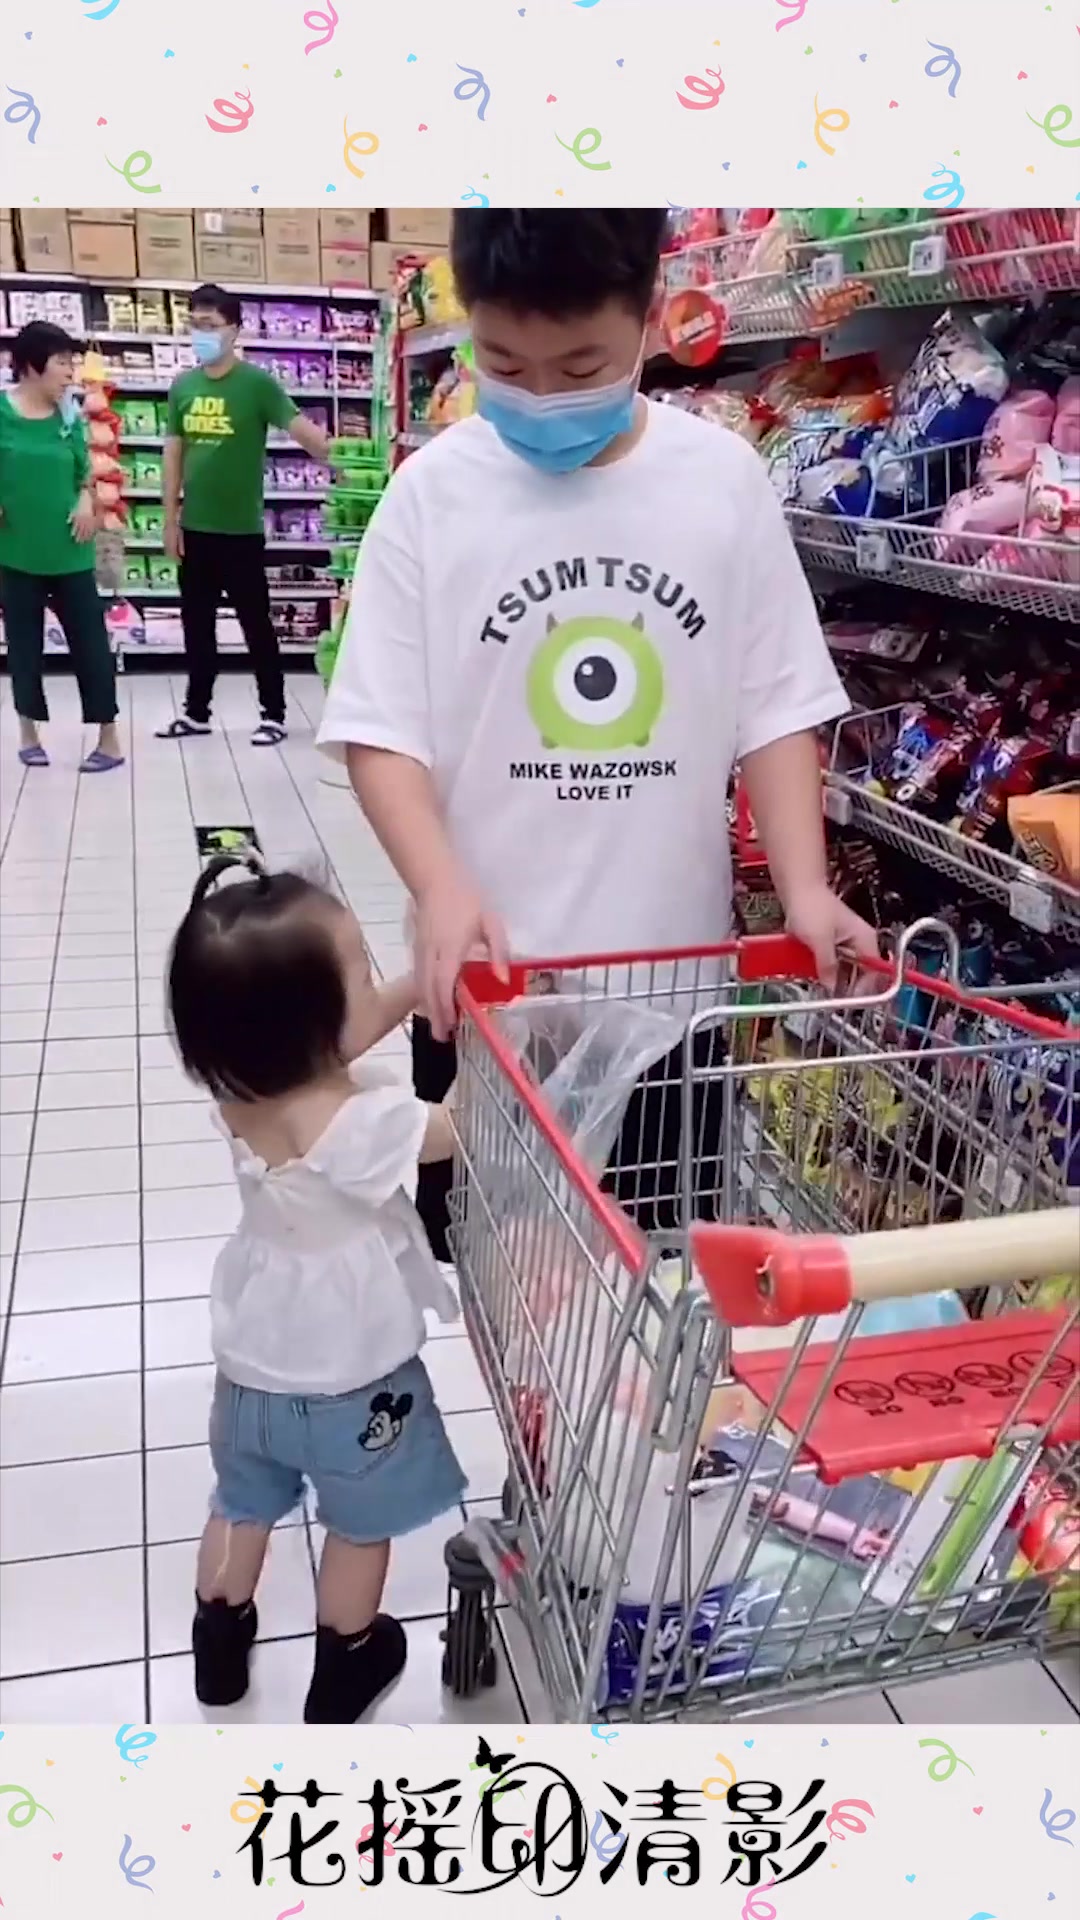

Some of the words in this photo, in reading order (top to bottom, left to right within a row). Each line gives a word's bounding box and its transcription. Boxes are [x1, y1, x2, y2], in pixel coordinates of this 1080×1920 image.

[480, 557, 588, 645] TSUM
[596, 556, 707, 640] TSUM
[509, 762, 563, 780] MIKE
[569, 760, 677, 780] WAZOWSK
[556, 785, 610, 801] LOVE
[616, 784, 634, 800] IT
